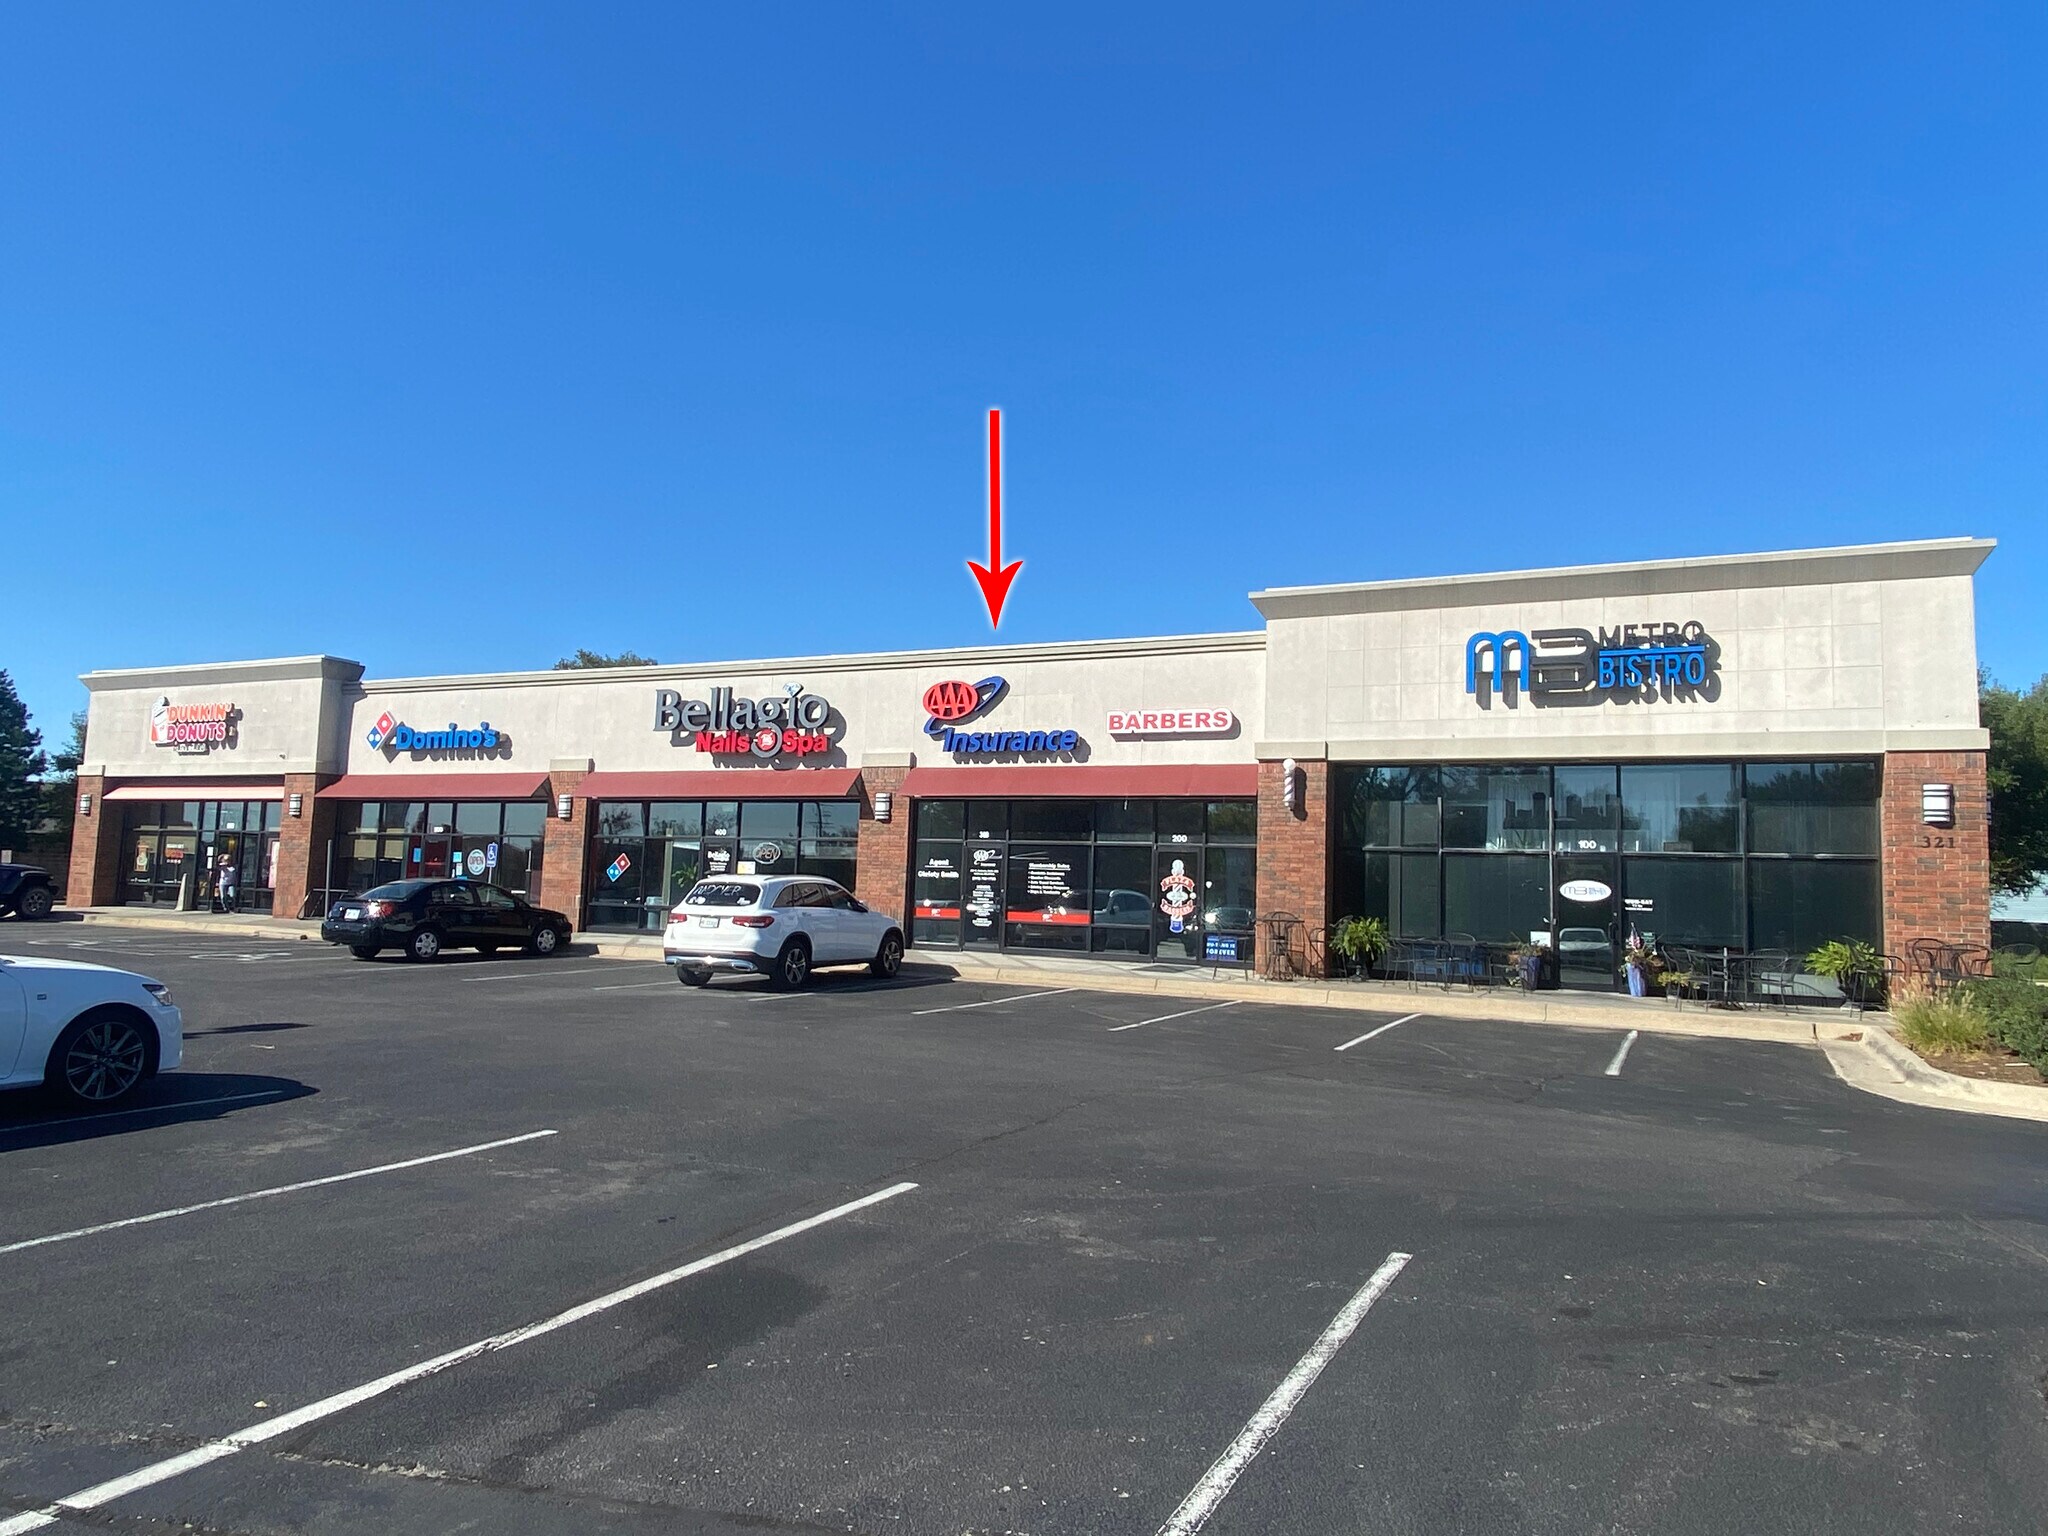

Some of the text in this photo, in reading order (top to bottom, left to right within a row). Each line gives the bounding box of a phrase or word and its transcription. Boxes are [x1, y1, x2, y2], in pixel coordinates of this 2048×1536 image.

[1598, 620, 1706, 648] METRO
[1599, 652, 1707, 689] BISTRO
[167, 703, 232, 723] DUNKIN'
[925, 682, 977, 718] AAA
[166, 722, 226, 742] DONUTS
[653, 682, 829, 758] Bellagio
[1108, 711, 1229, 731] BARBERS
[395, 721, 499, 750] Domino's
[696, 729, 829, 757] Nails Spa
[942, 727, 1080, 753] Insurance
[1171, 834, 1188, 843] 200
[1578, 840, 1597, 849] 100
[1922, 836, 1956, 849] 321
